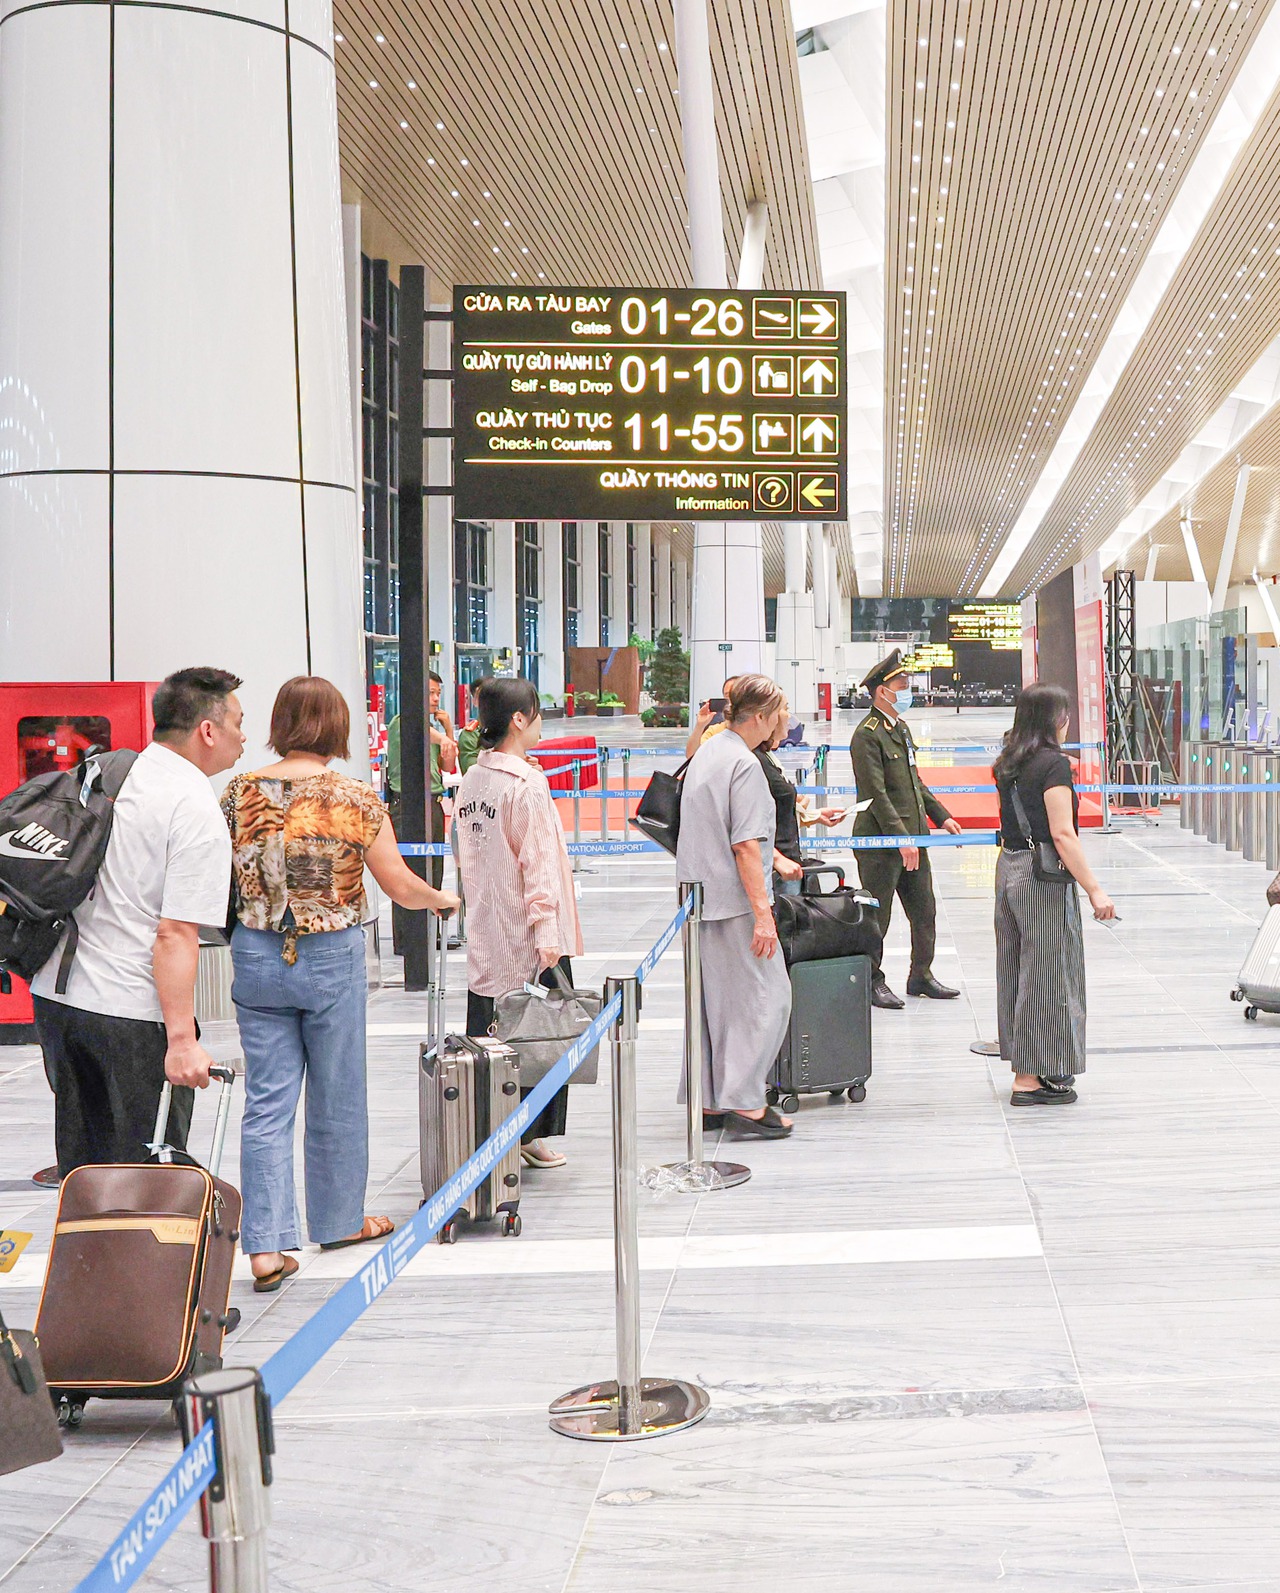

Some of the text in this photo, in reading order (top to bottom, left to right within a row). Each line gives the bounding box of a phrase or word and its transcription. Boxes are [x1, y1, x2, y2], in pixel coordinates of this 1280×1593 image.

[463, 291, 611, 312] CỬA RA TÀU BAY
[620, 297, 744, 337] 01-26
[571, 321, 612, 335] Gates
[462, 350, 613, 373] QUẦY TỰ GỬI HÀNH LÝ
[619, 355, 743, 395] 01-10
[511, 379, 539, 393] Self
[549, 380, 577, 396] Bag
[580, 380, 613, 395] Drop
[476, 408, 613, 432] QUẦY THỦ TỤC
[624, 412, 744, 451] 11-55
[488, 437, 613, 451] Check-in Counters
[600, 468, 750, 489] QUẦY THÔNG TIN
[676, 497, 749, 510] Information
[564, 790, 581, 798] TIA
[14, 821, 70, 857] NIKE
[410, 843, 436, 855] TIA
[609, 843, 645, 852] AIRPORT
[813, 838, 836, 847] KHÔNG
[567, 1044, 580, 1073] TIA
[360, 1253, 389, 1305] TIA
[110, 1429, 214, 1584] TAN SON NHAT
